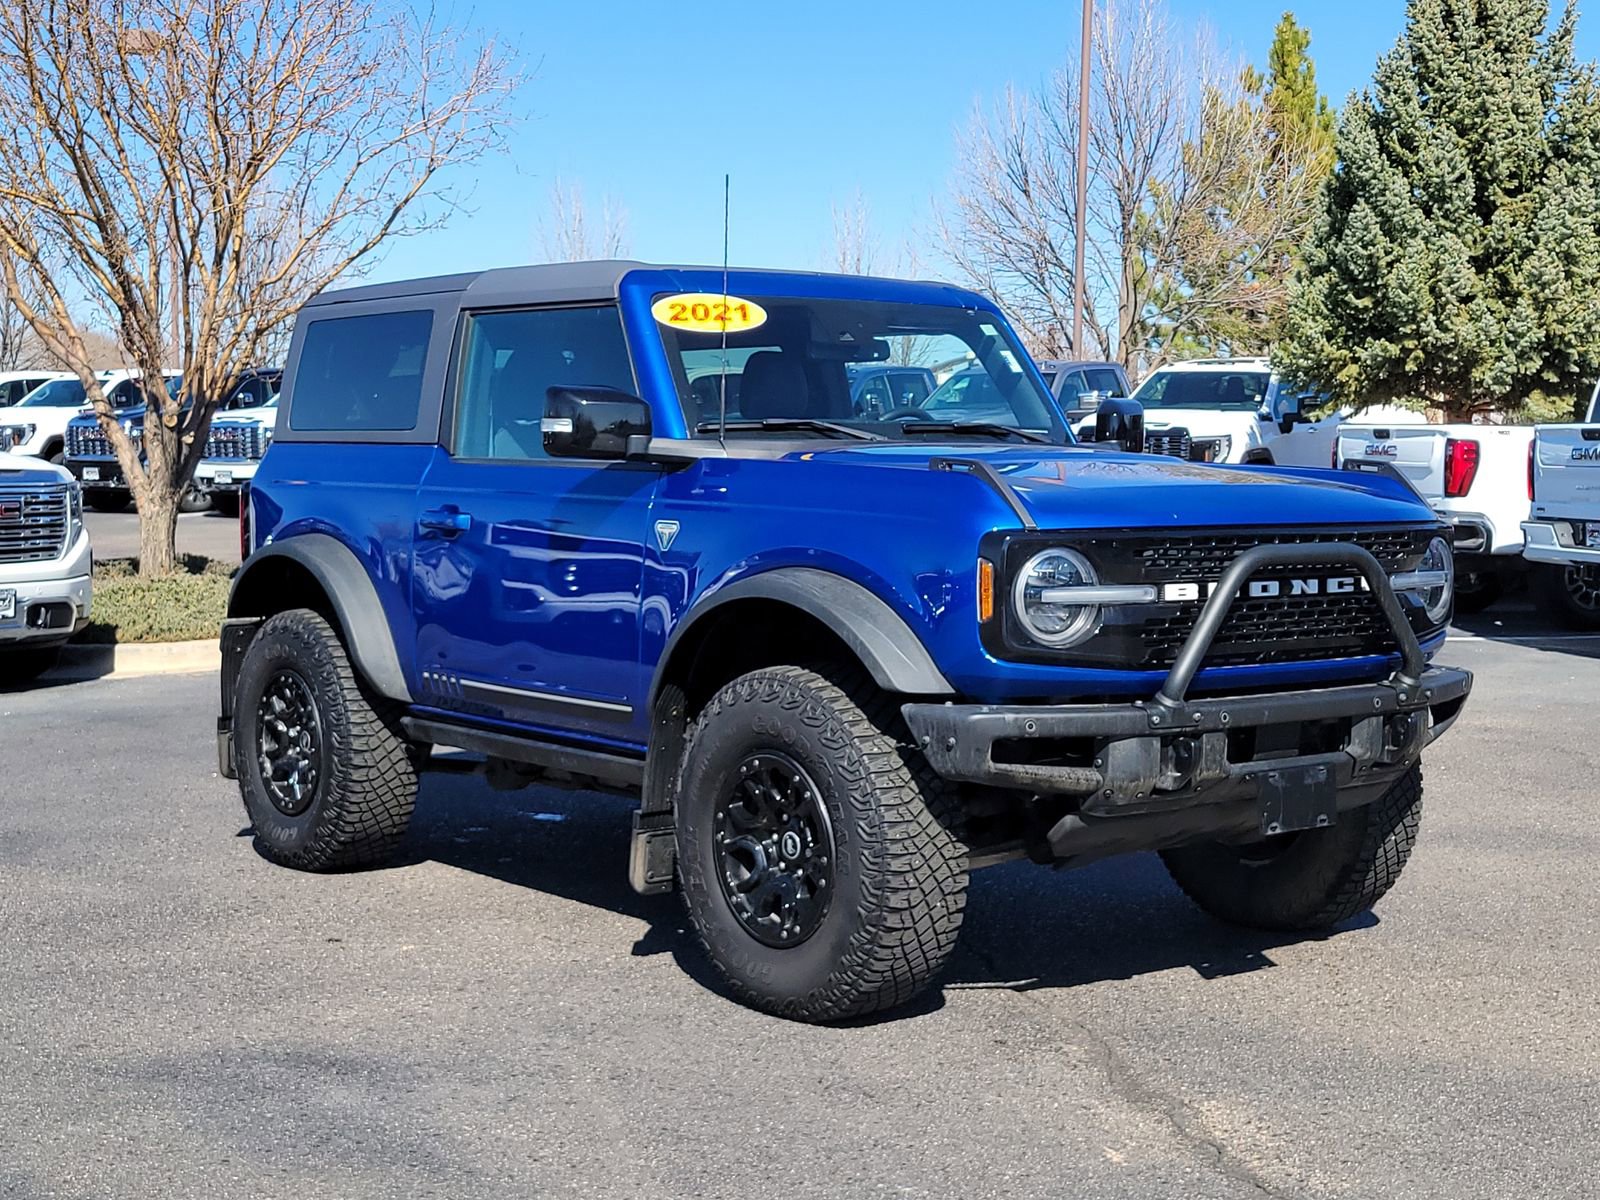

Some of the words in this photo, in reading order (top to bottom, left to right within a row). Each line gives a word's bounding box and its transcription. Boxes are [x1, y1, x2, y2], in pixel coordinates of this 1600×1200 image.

[669, 303, 749, 321] 2021
[1365, 444, 1398, 457] GMC
[1571, 447, 1600, 461] GM
[1164, 575, 1371, 602] BONC
